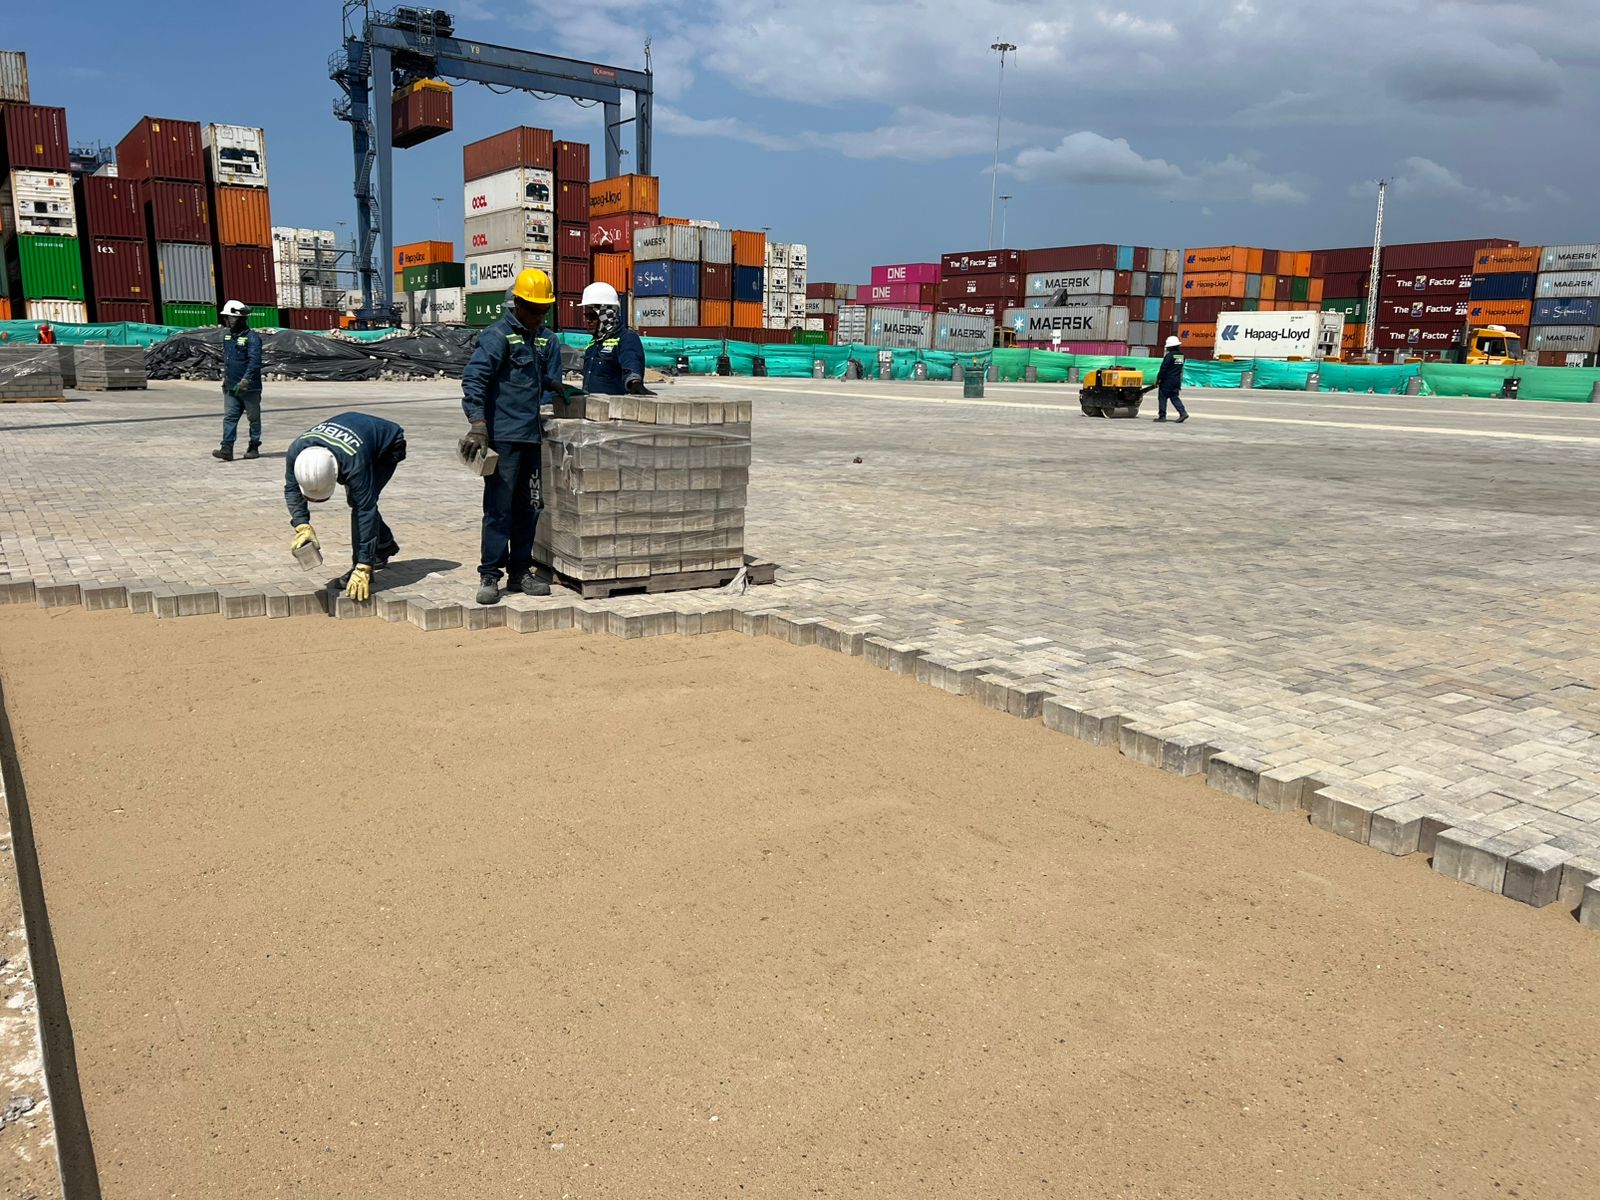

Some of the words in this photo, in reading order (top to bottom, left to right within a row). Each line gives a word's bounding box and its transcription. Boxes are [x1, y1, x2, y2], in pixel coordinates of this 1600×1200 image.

[470, 45, 480, 54] Y9
[97, 244, 115, 254] tex
[480, 263, 514, 280] MAERSK
[888, 267, 906, 279] ONE
[1046, 277, 1090, 288] MAERSK
[872, 286, 890, 298] ONE
[884, 323, 924, 335] MAERSK
[1030, 316, 1093, 330] MAERSK
[950, 328, 986, 338] MAERSK
[1244, 328, 1310, 341] Hapag-Lloyd
